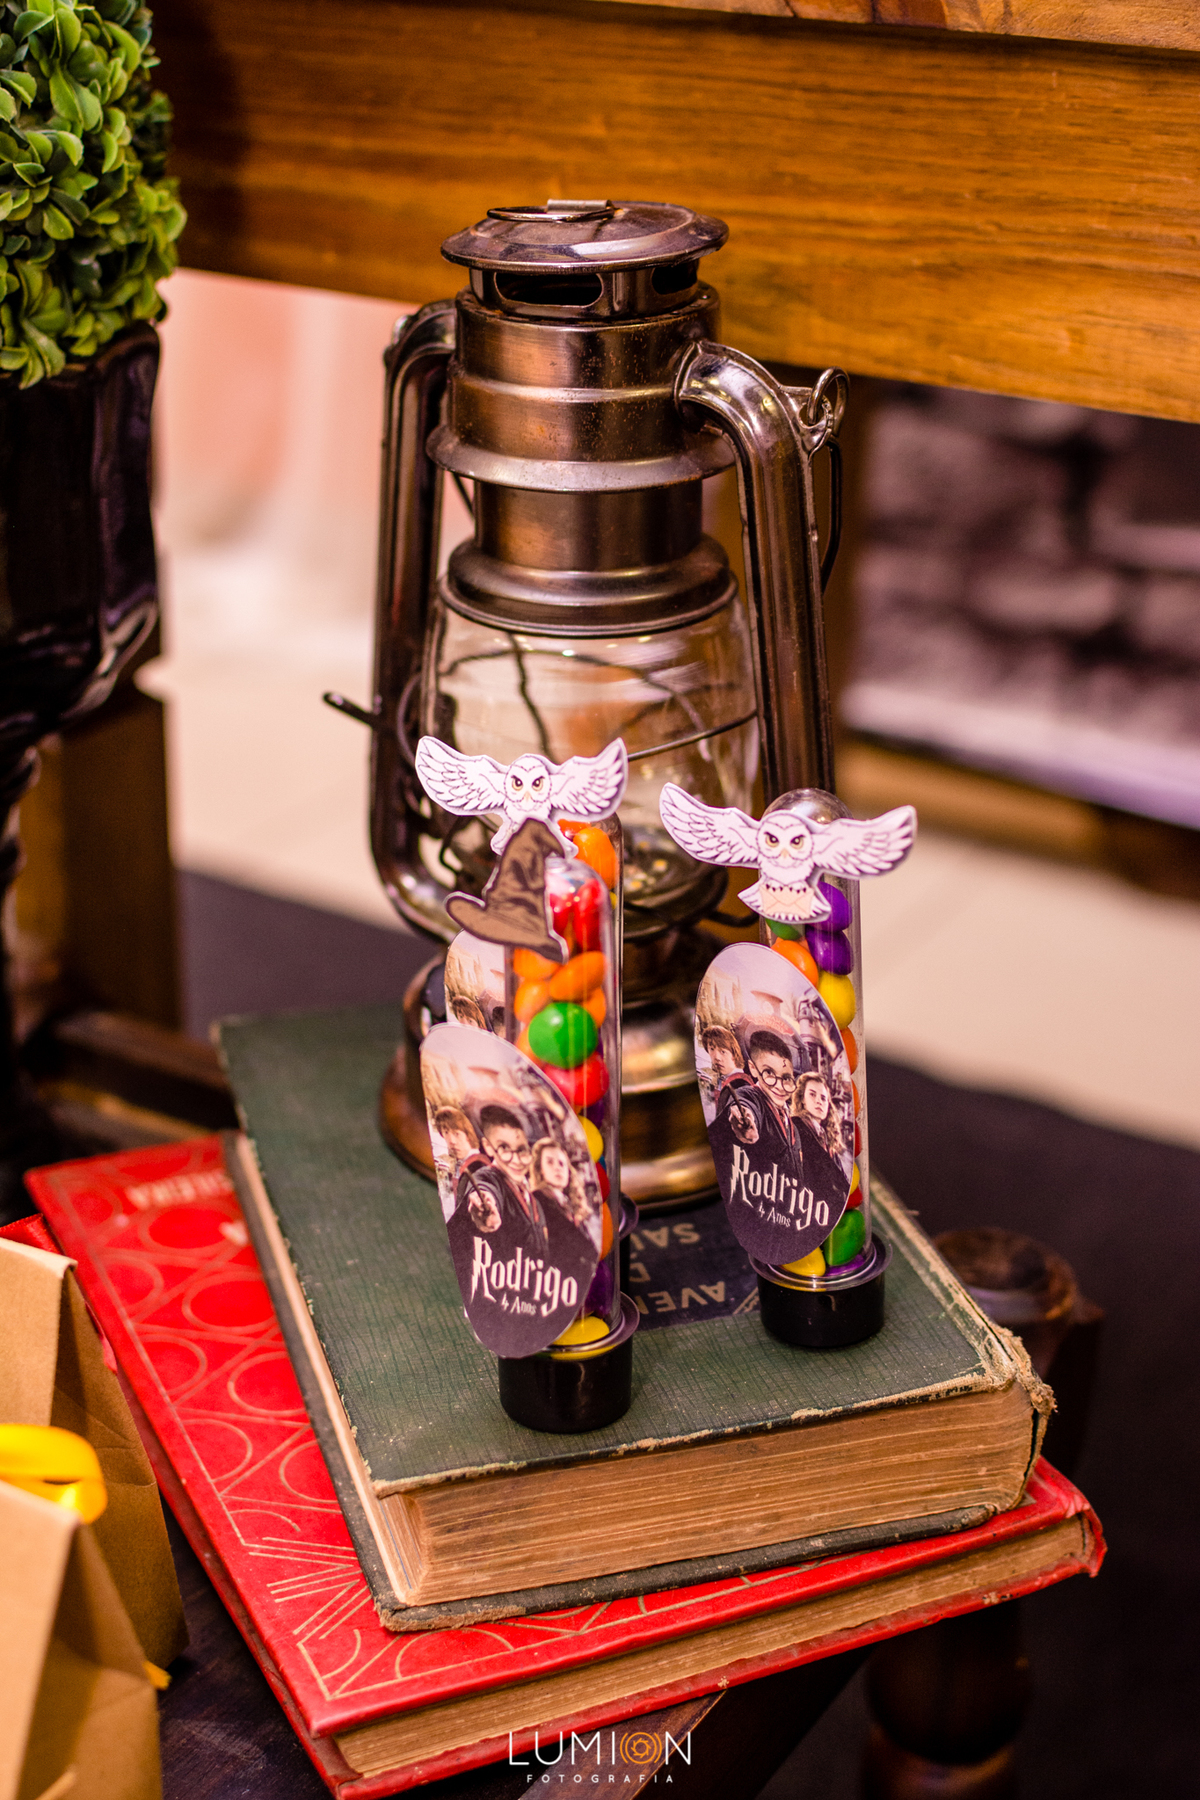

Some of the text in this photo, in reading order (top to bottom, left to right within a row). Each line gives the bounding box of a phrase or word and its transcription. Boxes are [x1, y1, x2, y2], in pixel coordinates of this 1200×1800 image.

[729, 1143, 830, 1231] Rodrigo
[758, 1201, 792, 1228] 4 Anos
[470, 1235, 579, 1318] Rodrigo
[501, 1292, 538, 1317] 4 Anos
